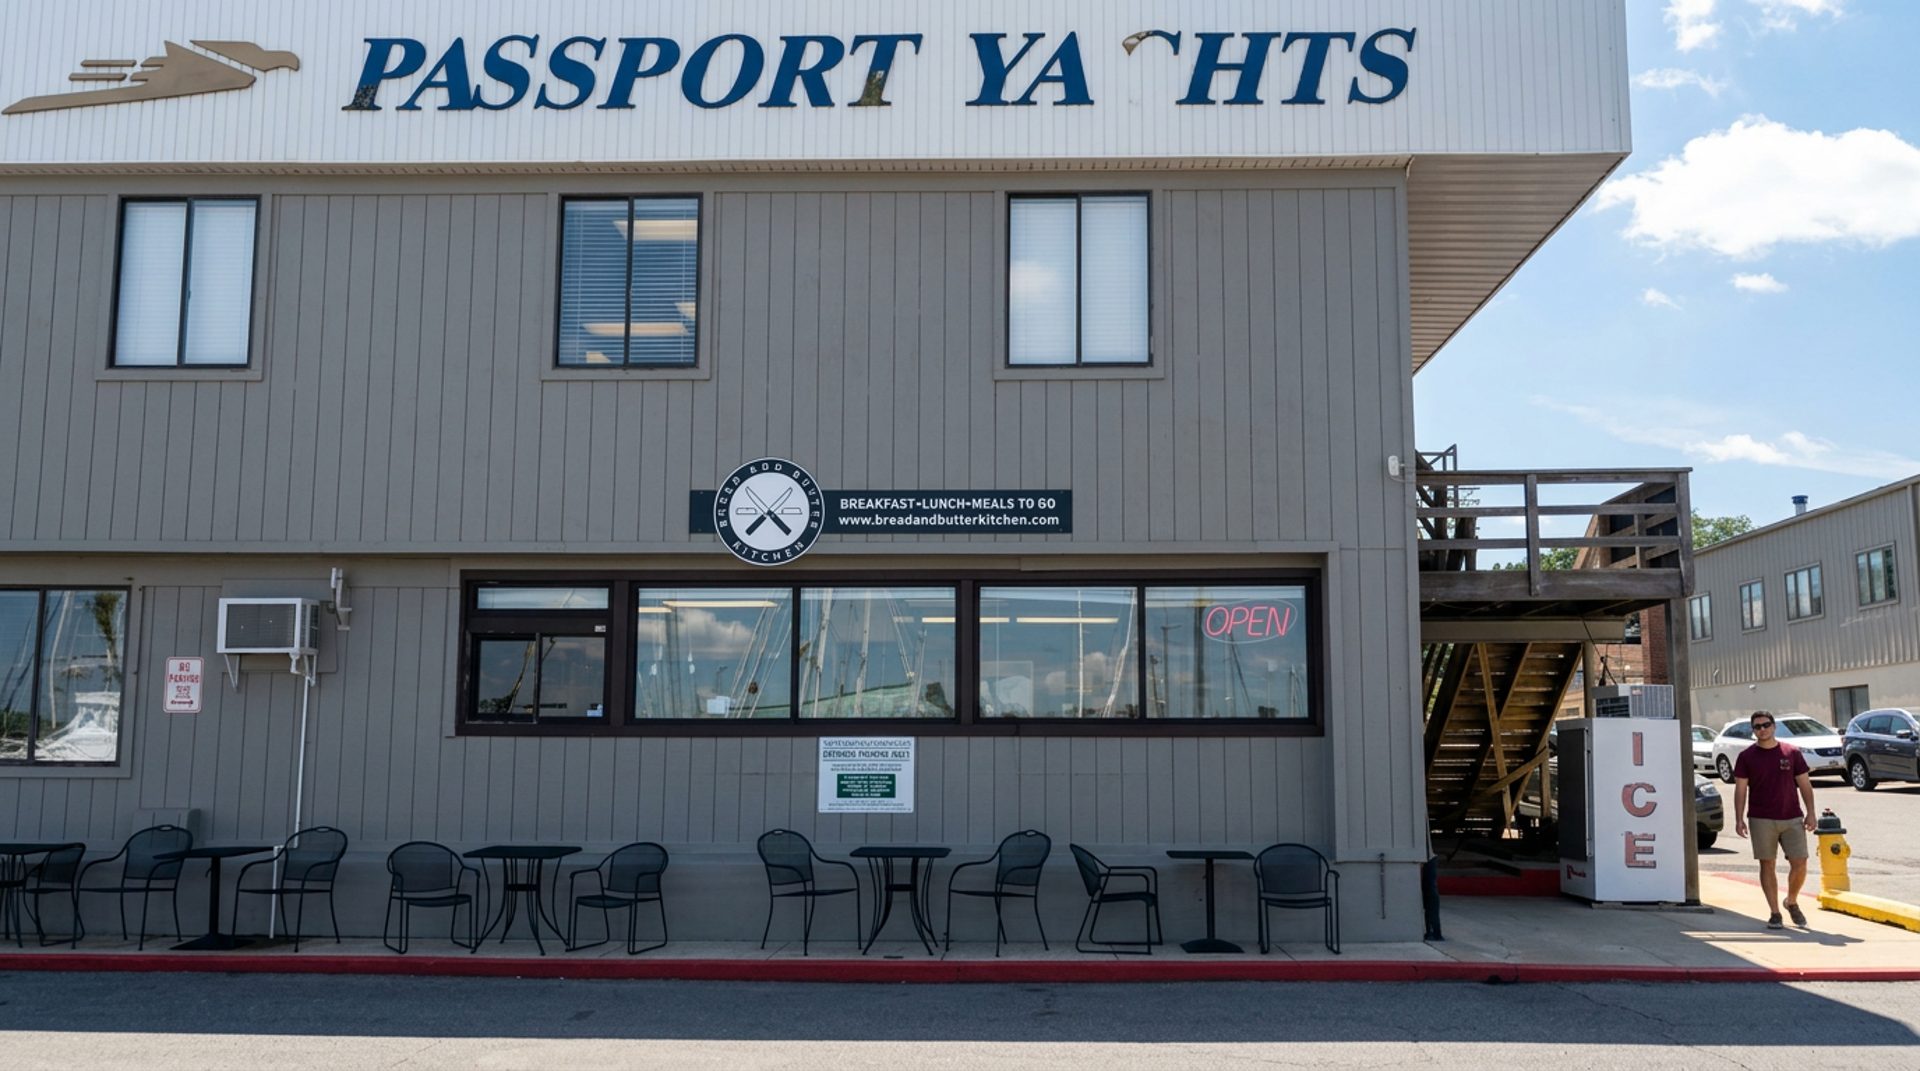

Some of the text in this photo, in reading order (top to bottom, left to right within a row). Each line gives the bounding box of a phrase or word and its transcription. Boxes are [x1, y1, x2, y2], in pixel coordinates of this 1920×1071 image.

[341, 34, 922, 111] PASSPORT
[839, 498, 1015, 510] BREAKFAST-LUNCH-MEALS
[1018, 498, 1034, 510] TO
[838, 514, 1060, 527] www.breadandbutterkitchen.com
[1205, 605, 1291, 637] OPEN
[1621, 731, 1658, 869] ICE
